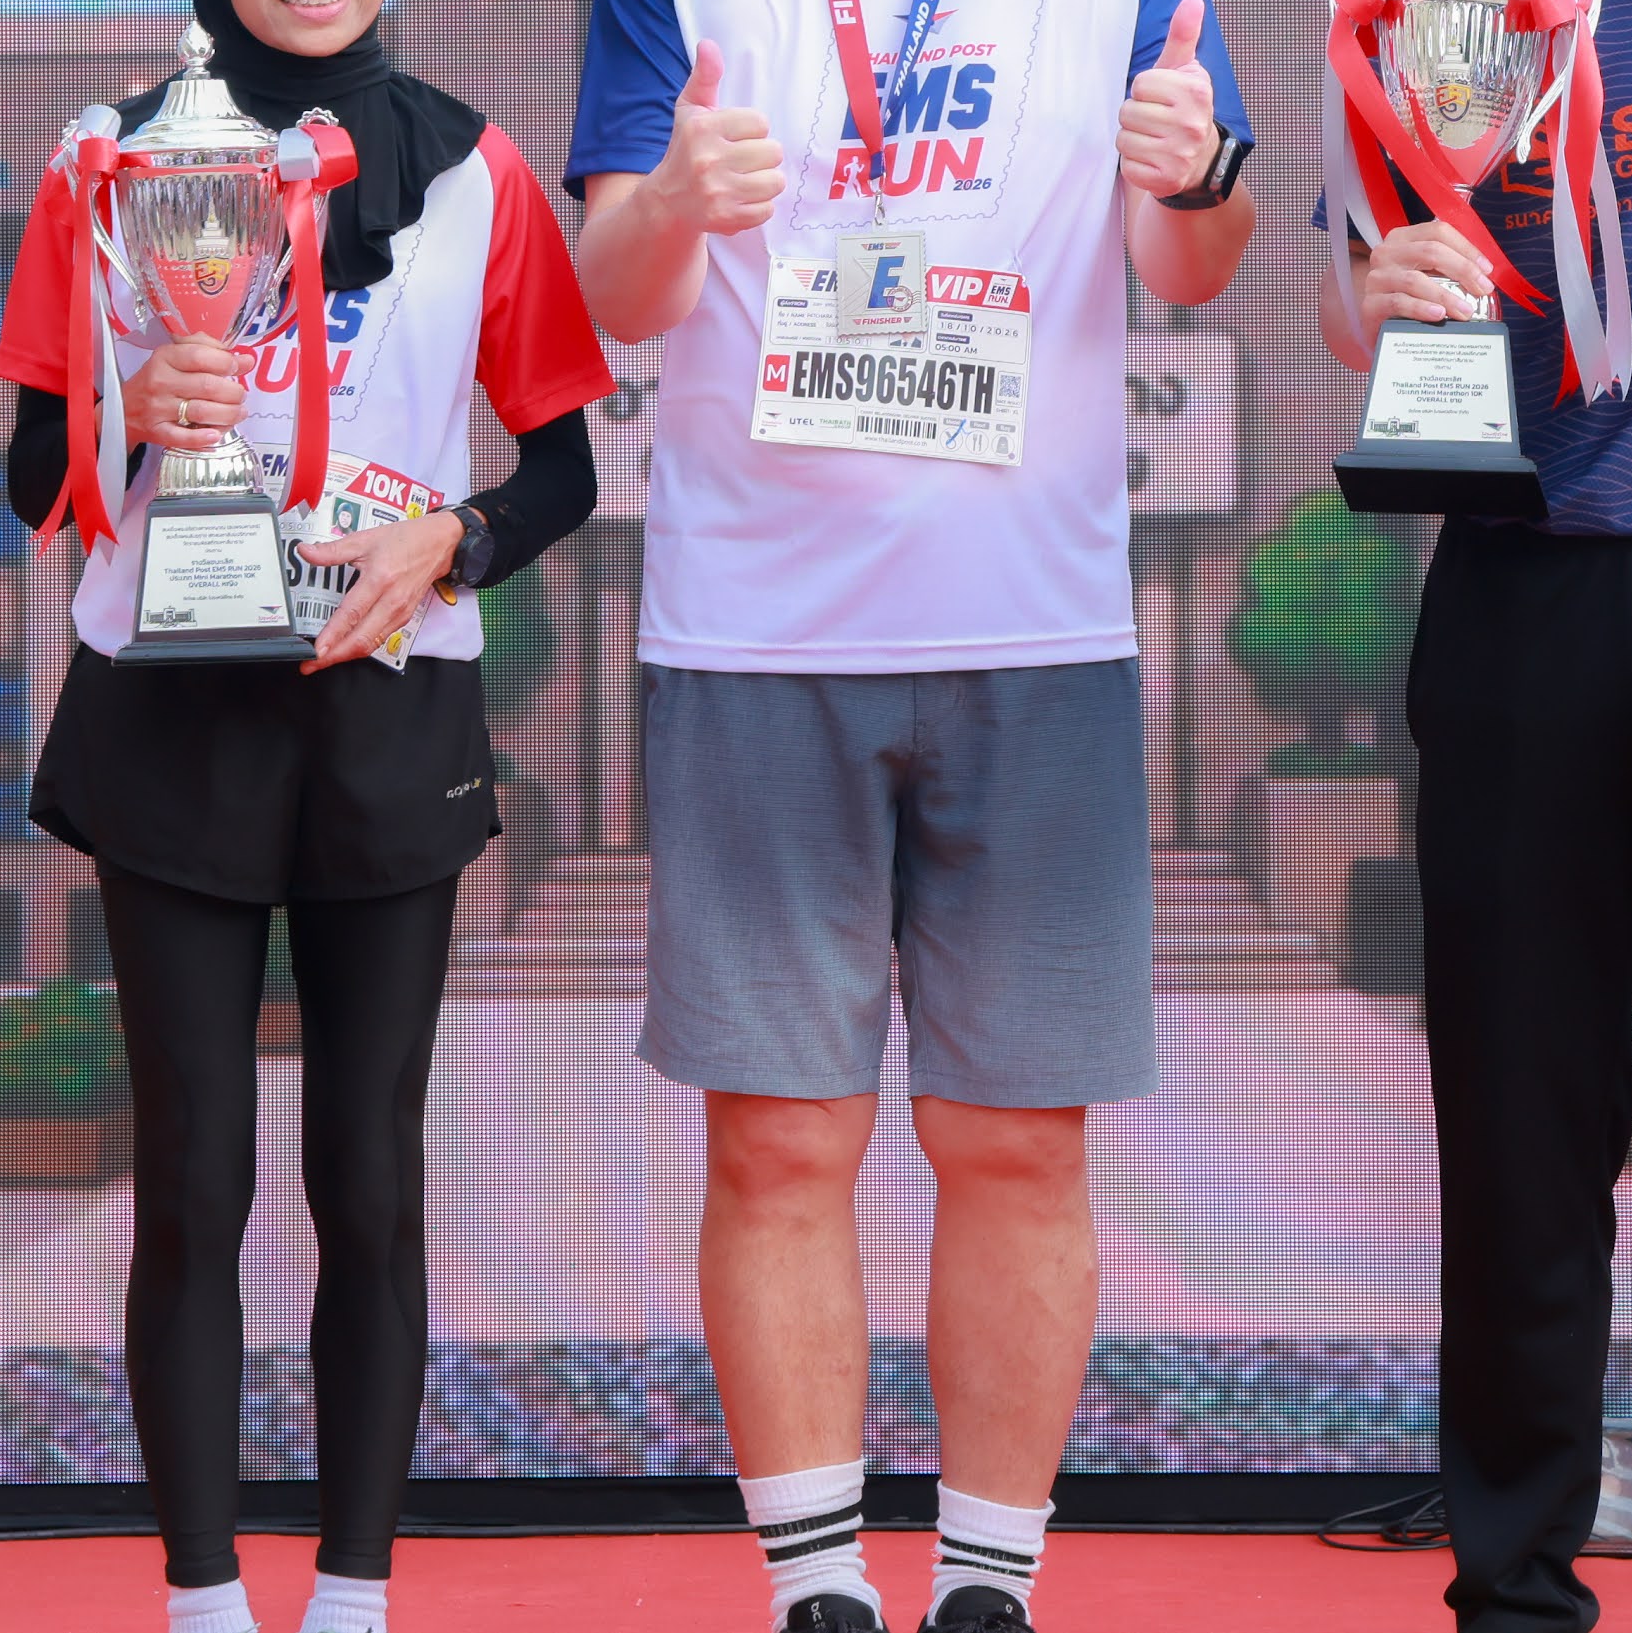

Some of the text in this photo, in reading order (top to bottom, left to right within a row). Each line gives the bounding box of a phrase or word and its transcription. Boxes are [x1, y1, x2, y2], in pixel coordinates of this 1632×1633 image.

[869, 44, 997, 65] HAIND POST
[893, 1, 930, 97] THAILAND
[828, 136, 985, 200] RUN
[953, 177, 993, 191] 2026
[867, 242, 885, 251] EMS
[931, 273, 984, 301] VIP
[991, 285, 1011, 296] EMS
[861, 316, 902, 326] FINISHER
[935, 343, 961, 353] 05:00
[765, 363, 787, 383] M
[792, 350, 996, 415] EMS96546TH
[329, 385, 356, 396] 026
[789, 417, 815, 426] UTEL
[363, 469, 407, 506] 10K
[411, 494, 427, 507] EMS
